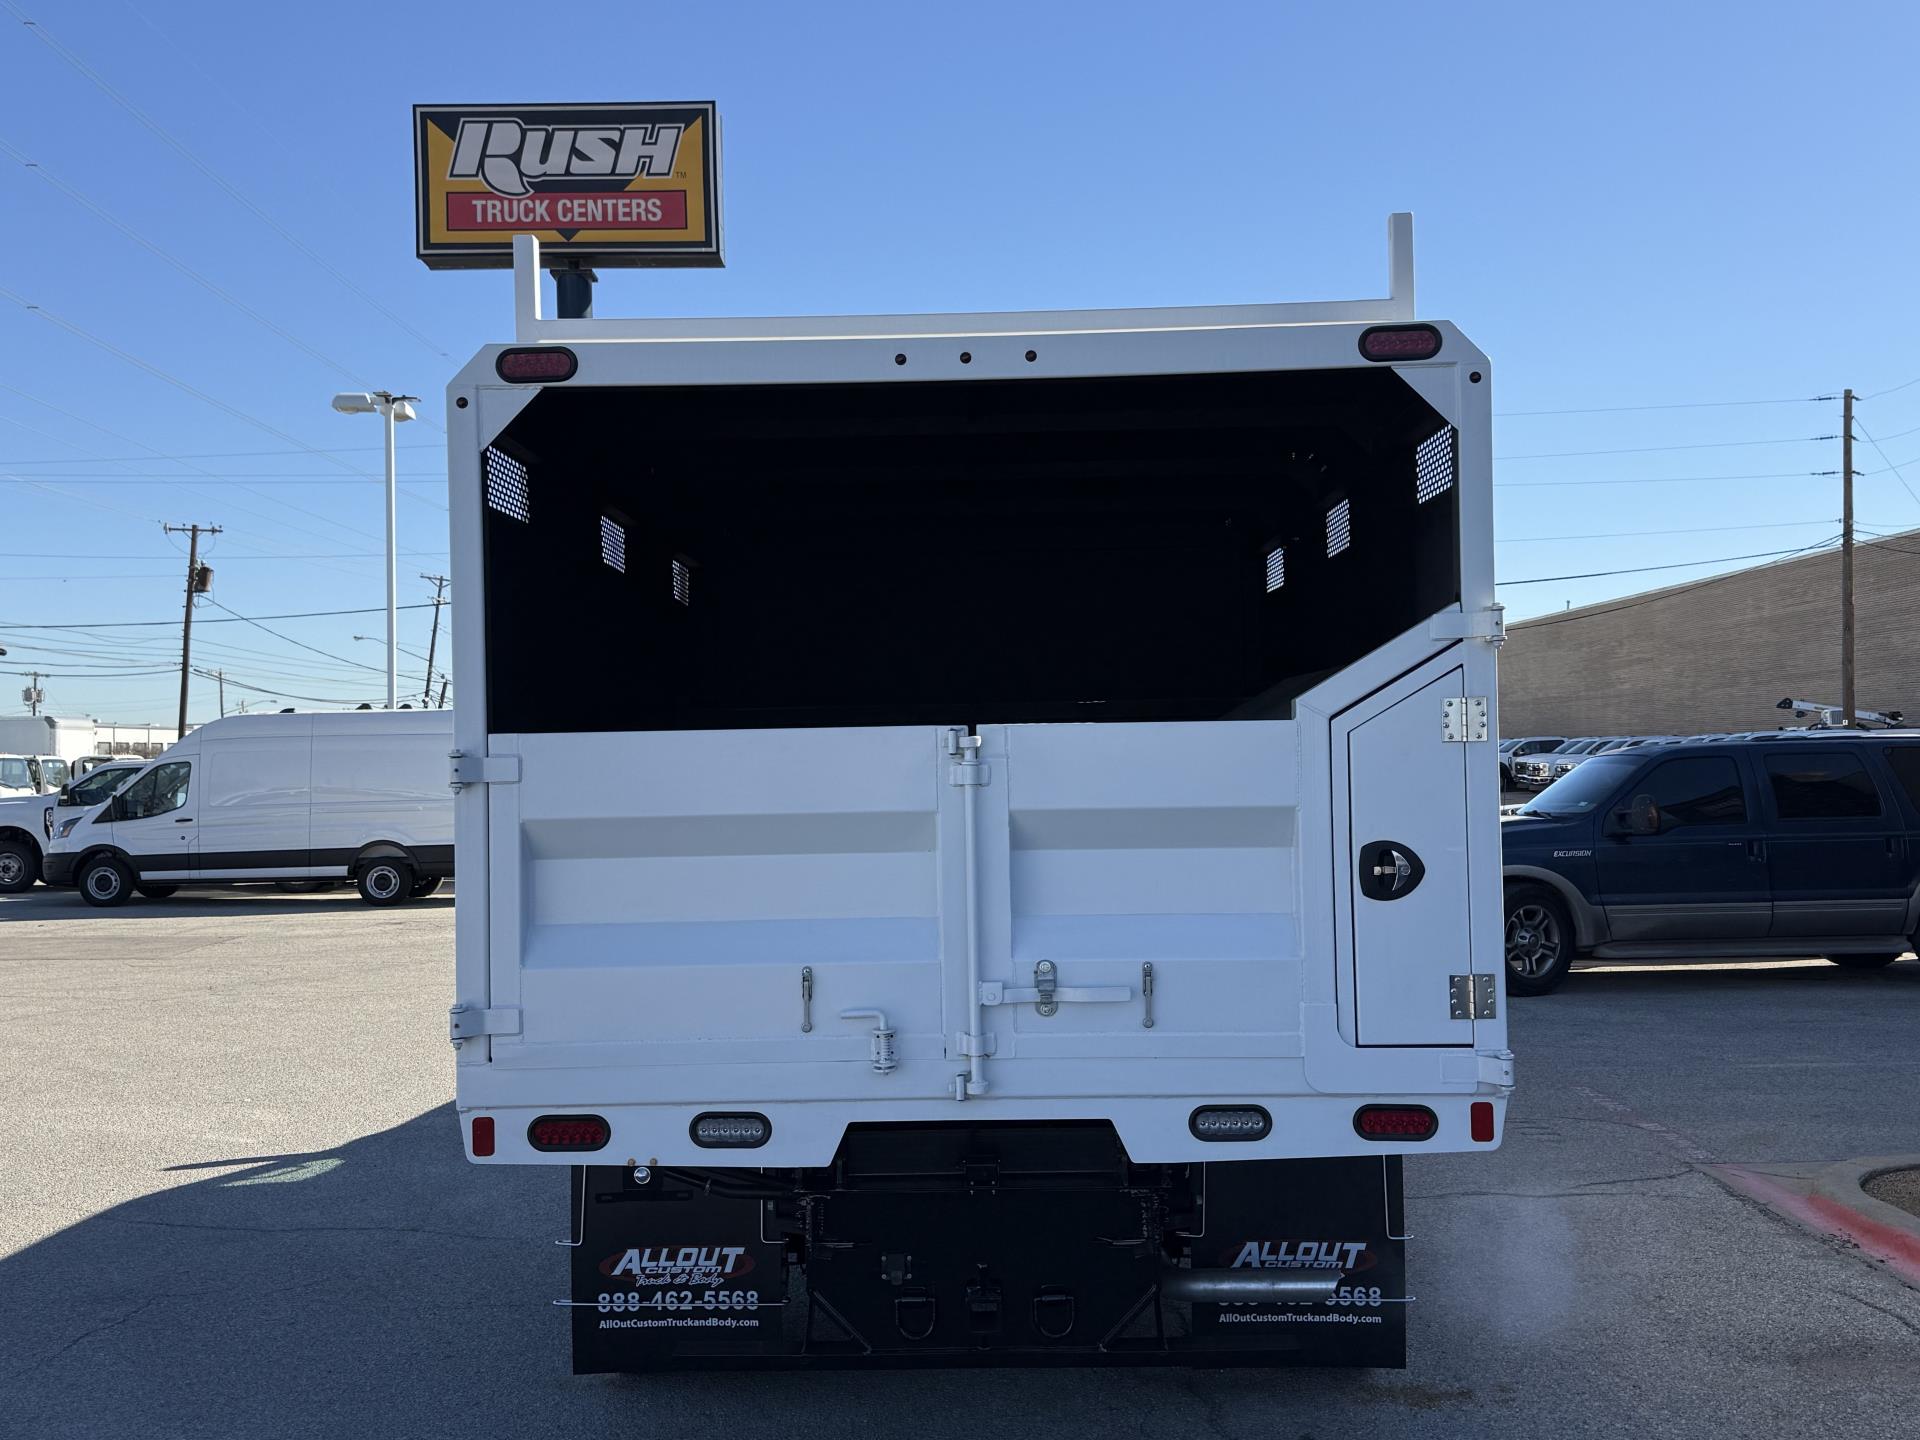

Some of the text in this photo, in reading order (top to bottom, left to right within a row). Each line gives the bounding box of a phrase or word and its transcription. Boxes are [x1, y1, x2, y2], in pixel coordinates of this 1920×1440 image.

[447, 117, 685, 198] RUSH
[472, 198, 662, 223] TRUCK CENTERS
[611, 1247, 745, 1276] ALLOUT
[1231, 1241, 1367, 1269] ALLOUT
[597, 1290, 759, 1313] 888-462-5568
[599, 1318, 759, 1329] AllOutCustomTruckandBody.com
[1218, 1313, 1382, 1324] AllOutCustomTruckandBody.com
